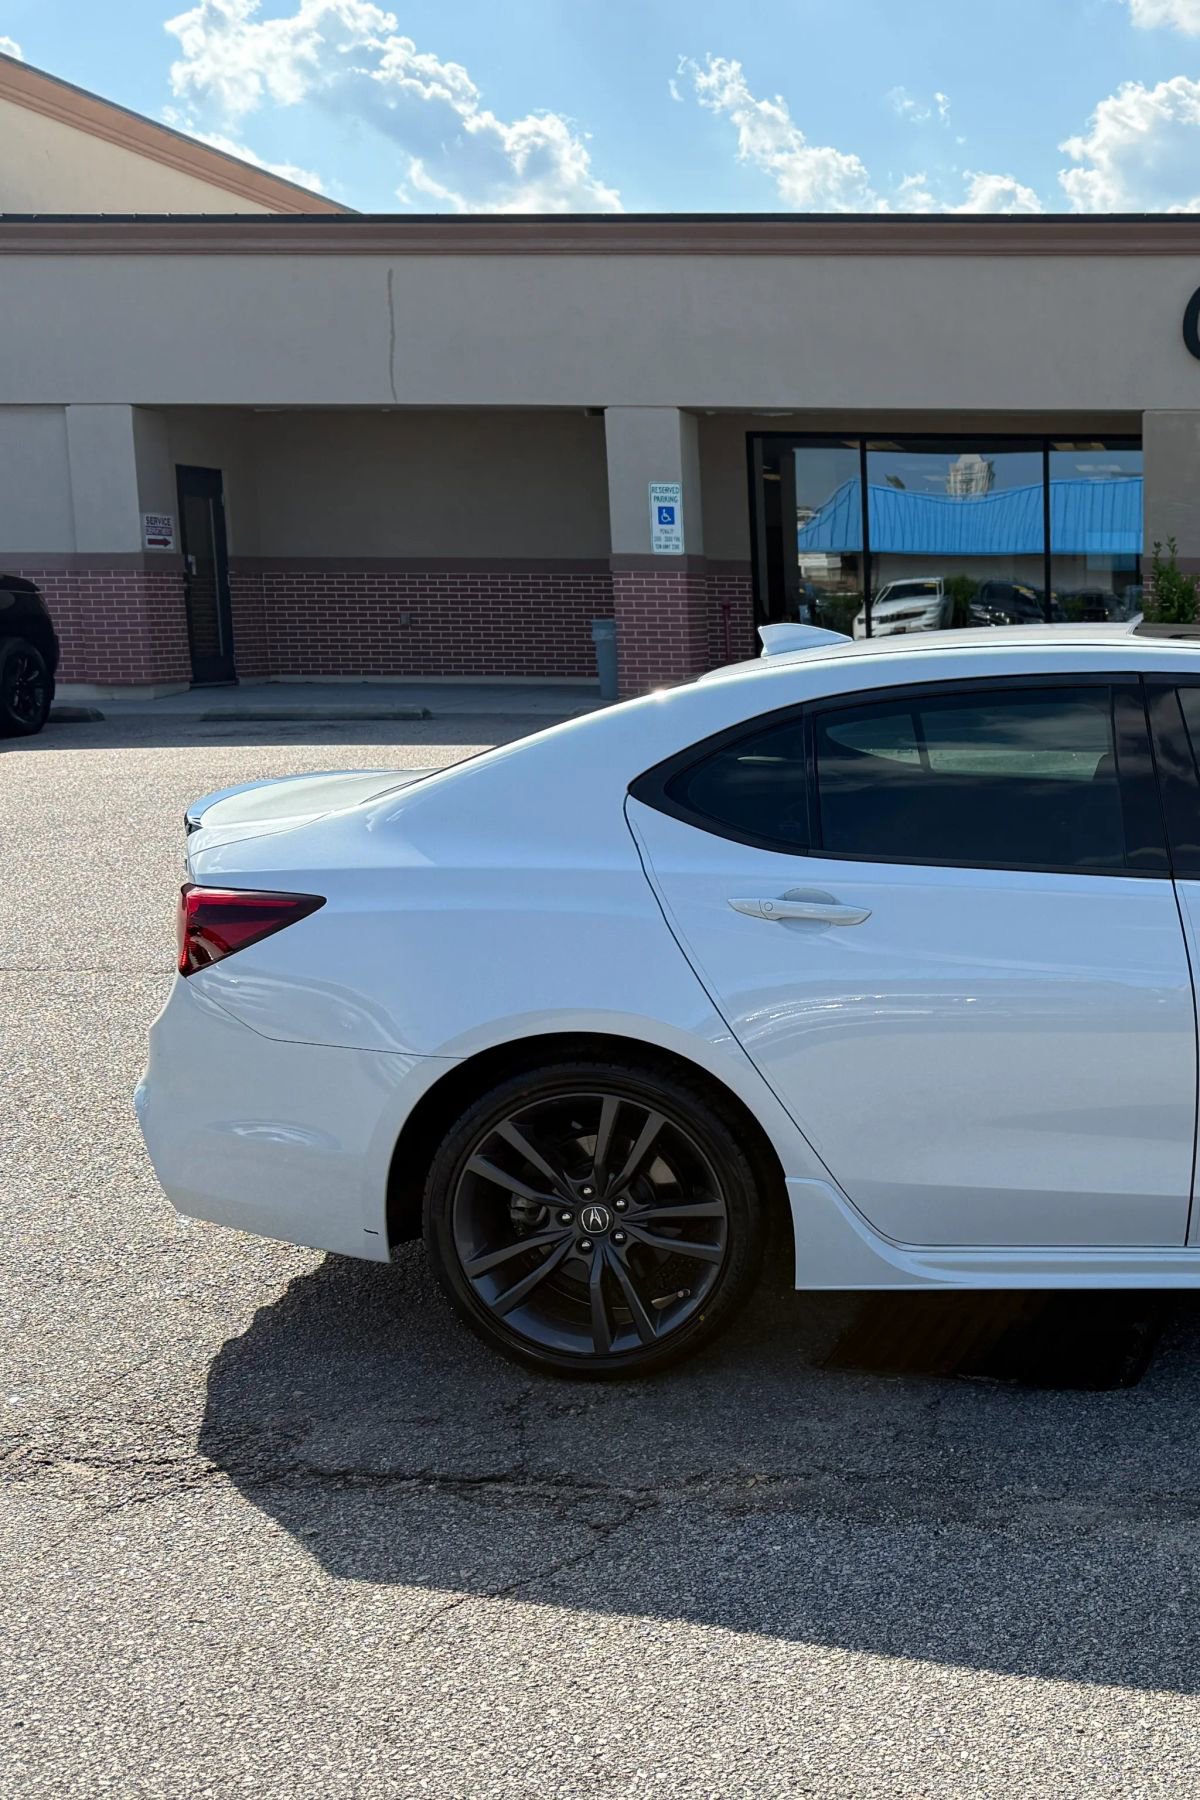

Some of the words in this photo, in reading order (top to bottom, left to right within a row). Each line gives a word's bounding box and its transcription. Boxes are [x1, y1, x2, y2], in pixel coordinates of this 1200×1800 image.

[651, 486, 680, 494] RESERVED
[653, 495, 678, 503] PARKING
[145, 516, 171, 526] SERVICE
